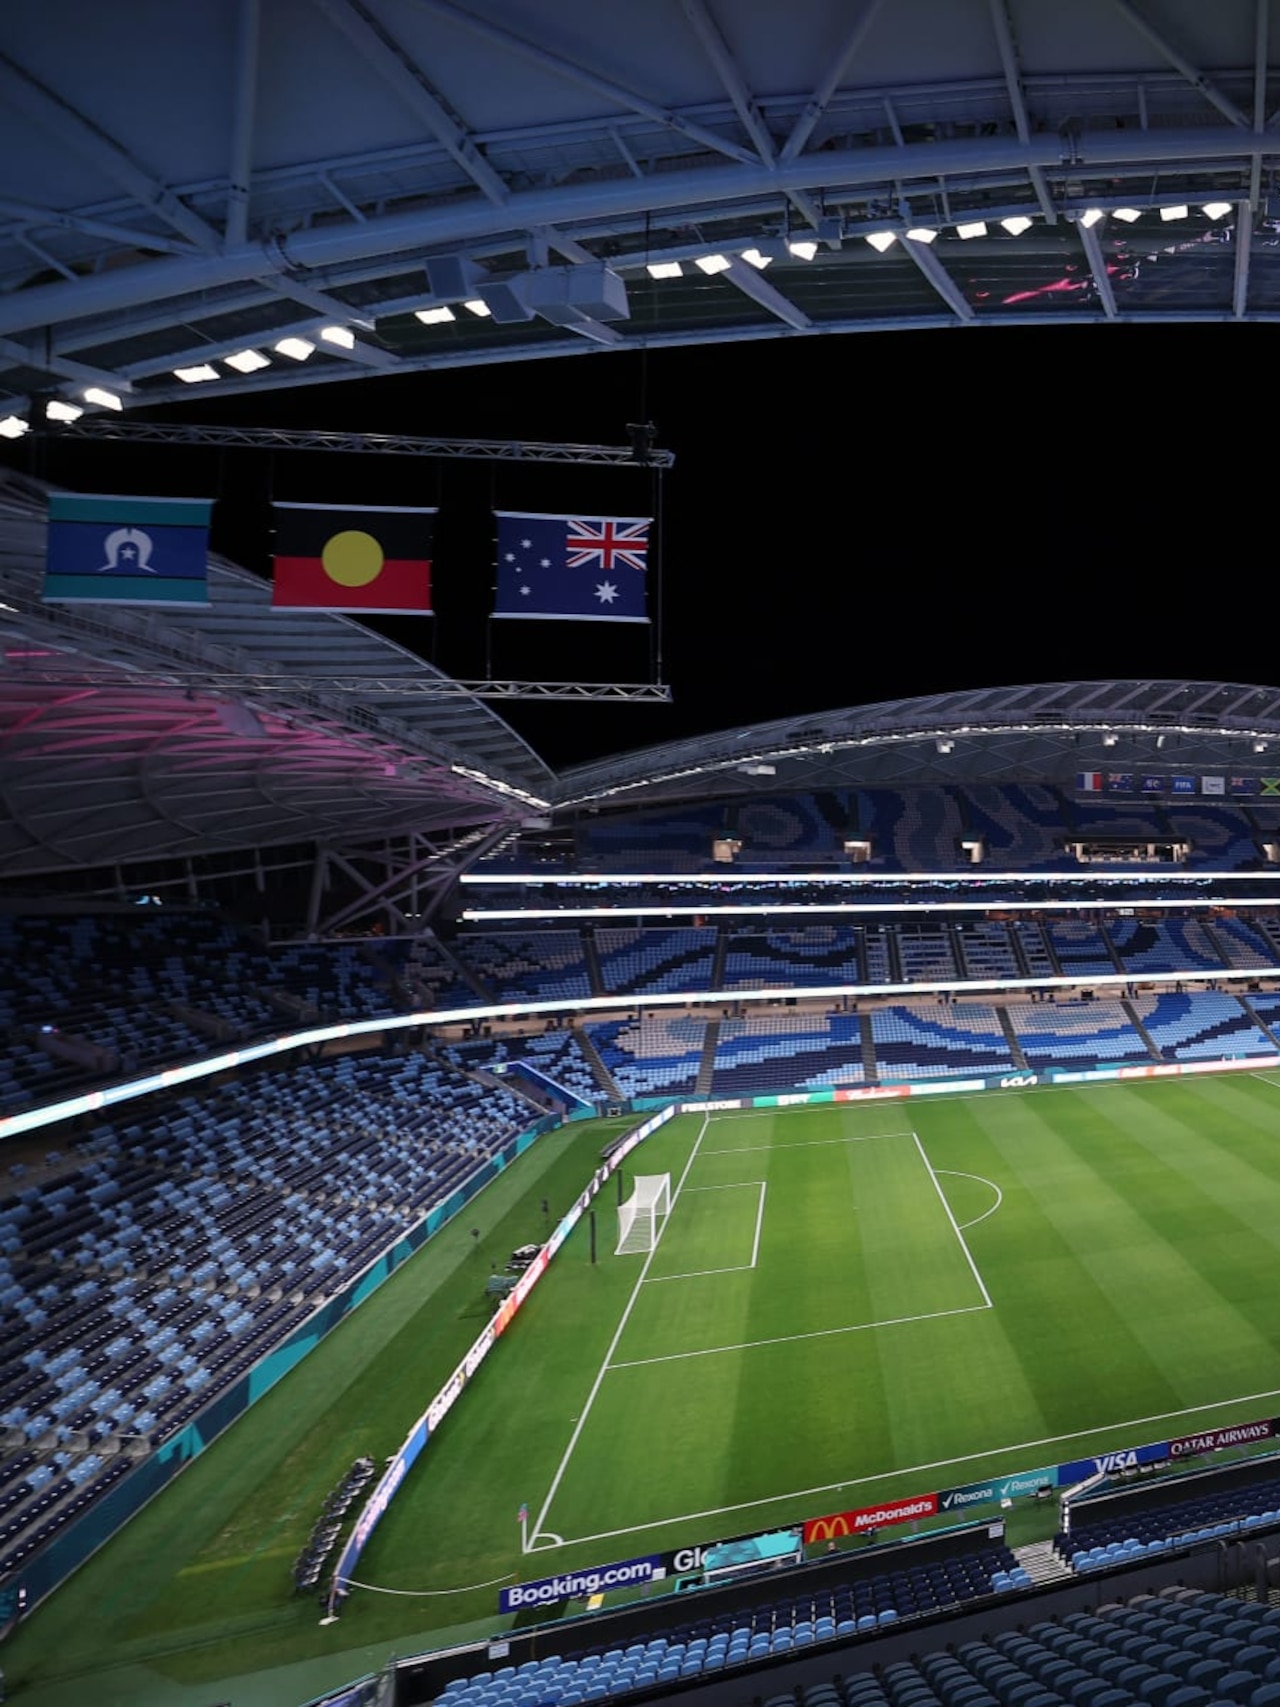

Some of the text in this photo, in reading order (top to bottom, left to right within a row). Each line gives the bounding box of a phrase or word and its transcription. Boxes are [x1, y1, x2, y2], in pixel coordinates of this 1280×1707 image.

[1170, 1423, 1269, 1456] QATAR AIRWAYS
[1093, 1451, 1138, 1473] VISA
[953, 1487, 993, 1505] Rexona
[1011, 1475, 1049, 1492] Rexona
[854, 1500, 933, 1528] McDonald's
[508, 1562, 652, 1607] Booking.com
